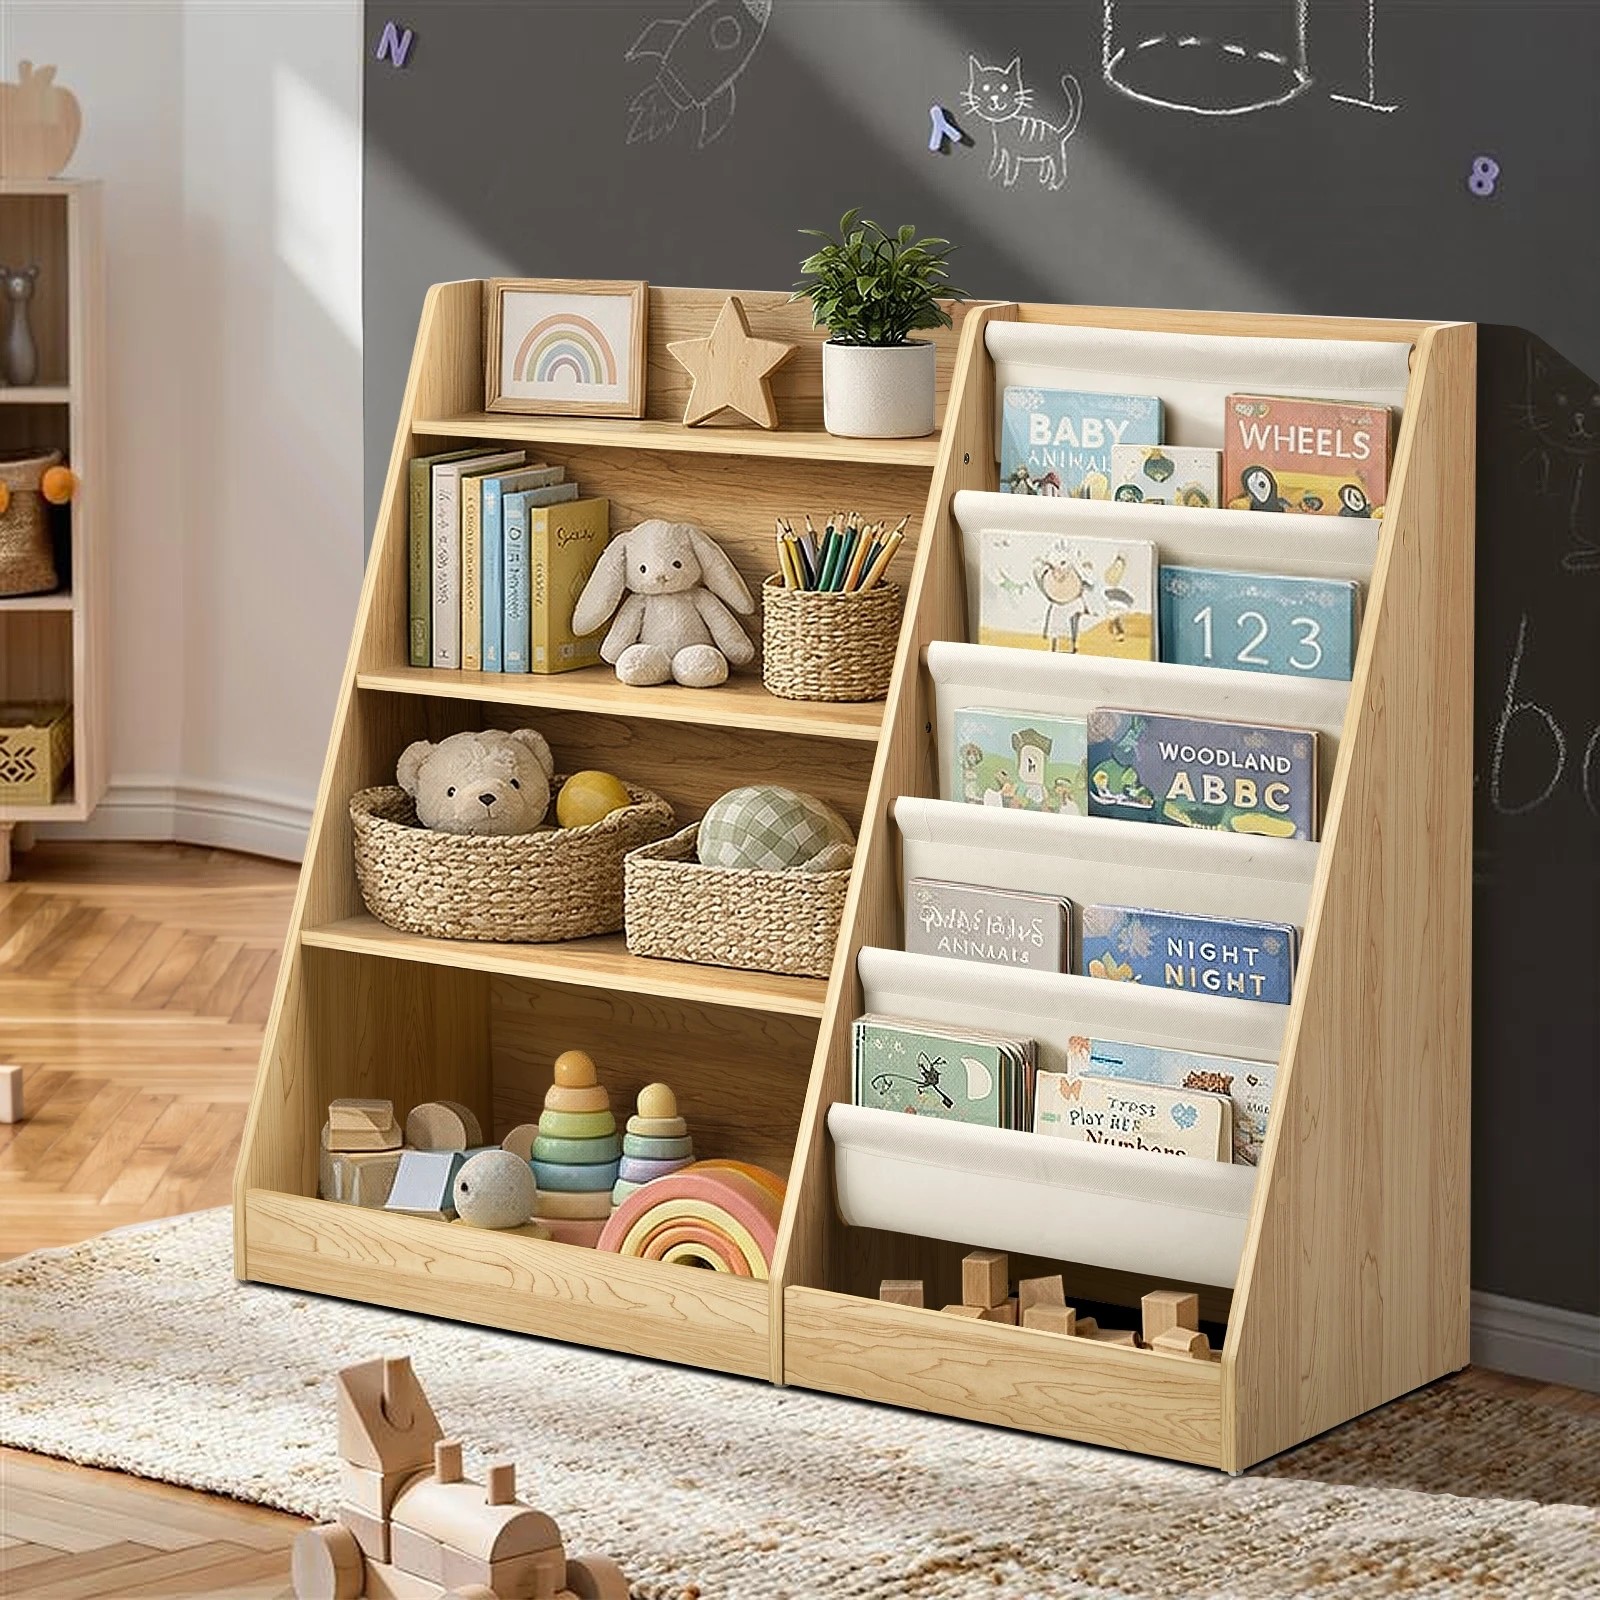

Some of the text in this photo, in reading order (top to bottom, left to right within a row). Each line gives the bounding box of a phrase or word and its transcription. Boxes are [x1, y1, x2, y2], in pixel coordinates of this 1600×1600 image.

[376, 20, 413, 67] N
[1468, 156, 1501, 196] 8
[1029, 412, 1129, 448] BABY
[1239, 419, 1371, 460] WHEELS
[1158, 741, 1291, 774] WOODLAND
[1165, 771, 1290, 813] ABBC
[1167, 937, 1259, 966] NIGHT
[1165, 963, 1266, 996] NIGHT
